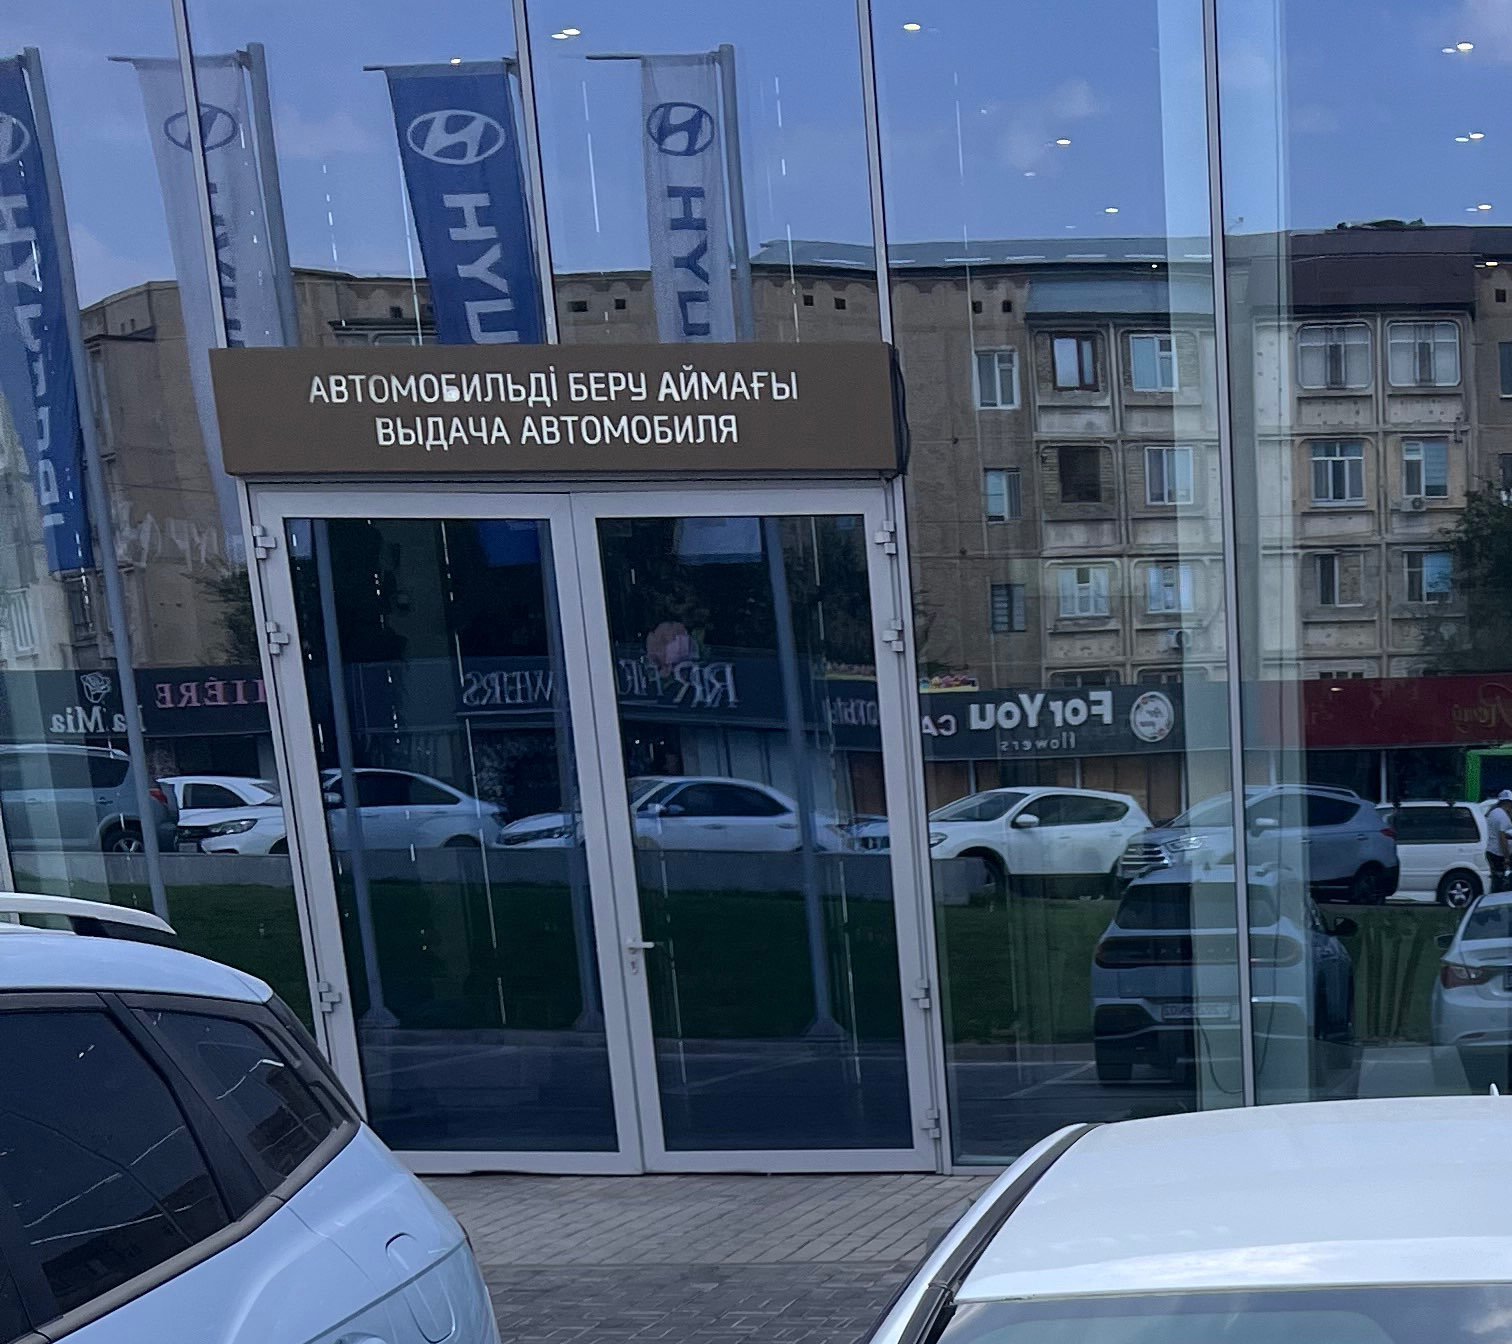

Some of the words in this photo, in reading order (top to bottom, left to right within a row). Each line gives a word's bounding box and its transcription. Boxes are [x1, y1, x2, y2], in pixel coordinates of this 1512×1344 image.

[568, 372, 648, 402] БЕРУ
[657, 364, 799, 402] АЙМАҒЫ
[375, 415, 512, 452] ВЫДАЧА
[520, 414, 739, 446] АВТОМОБИЛЯ
